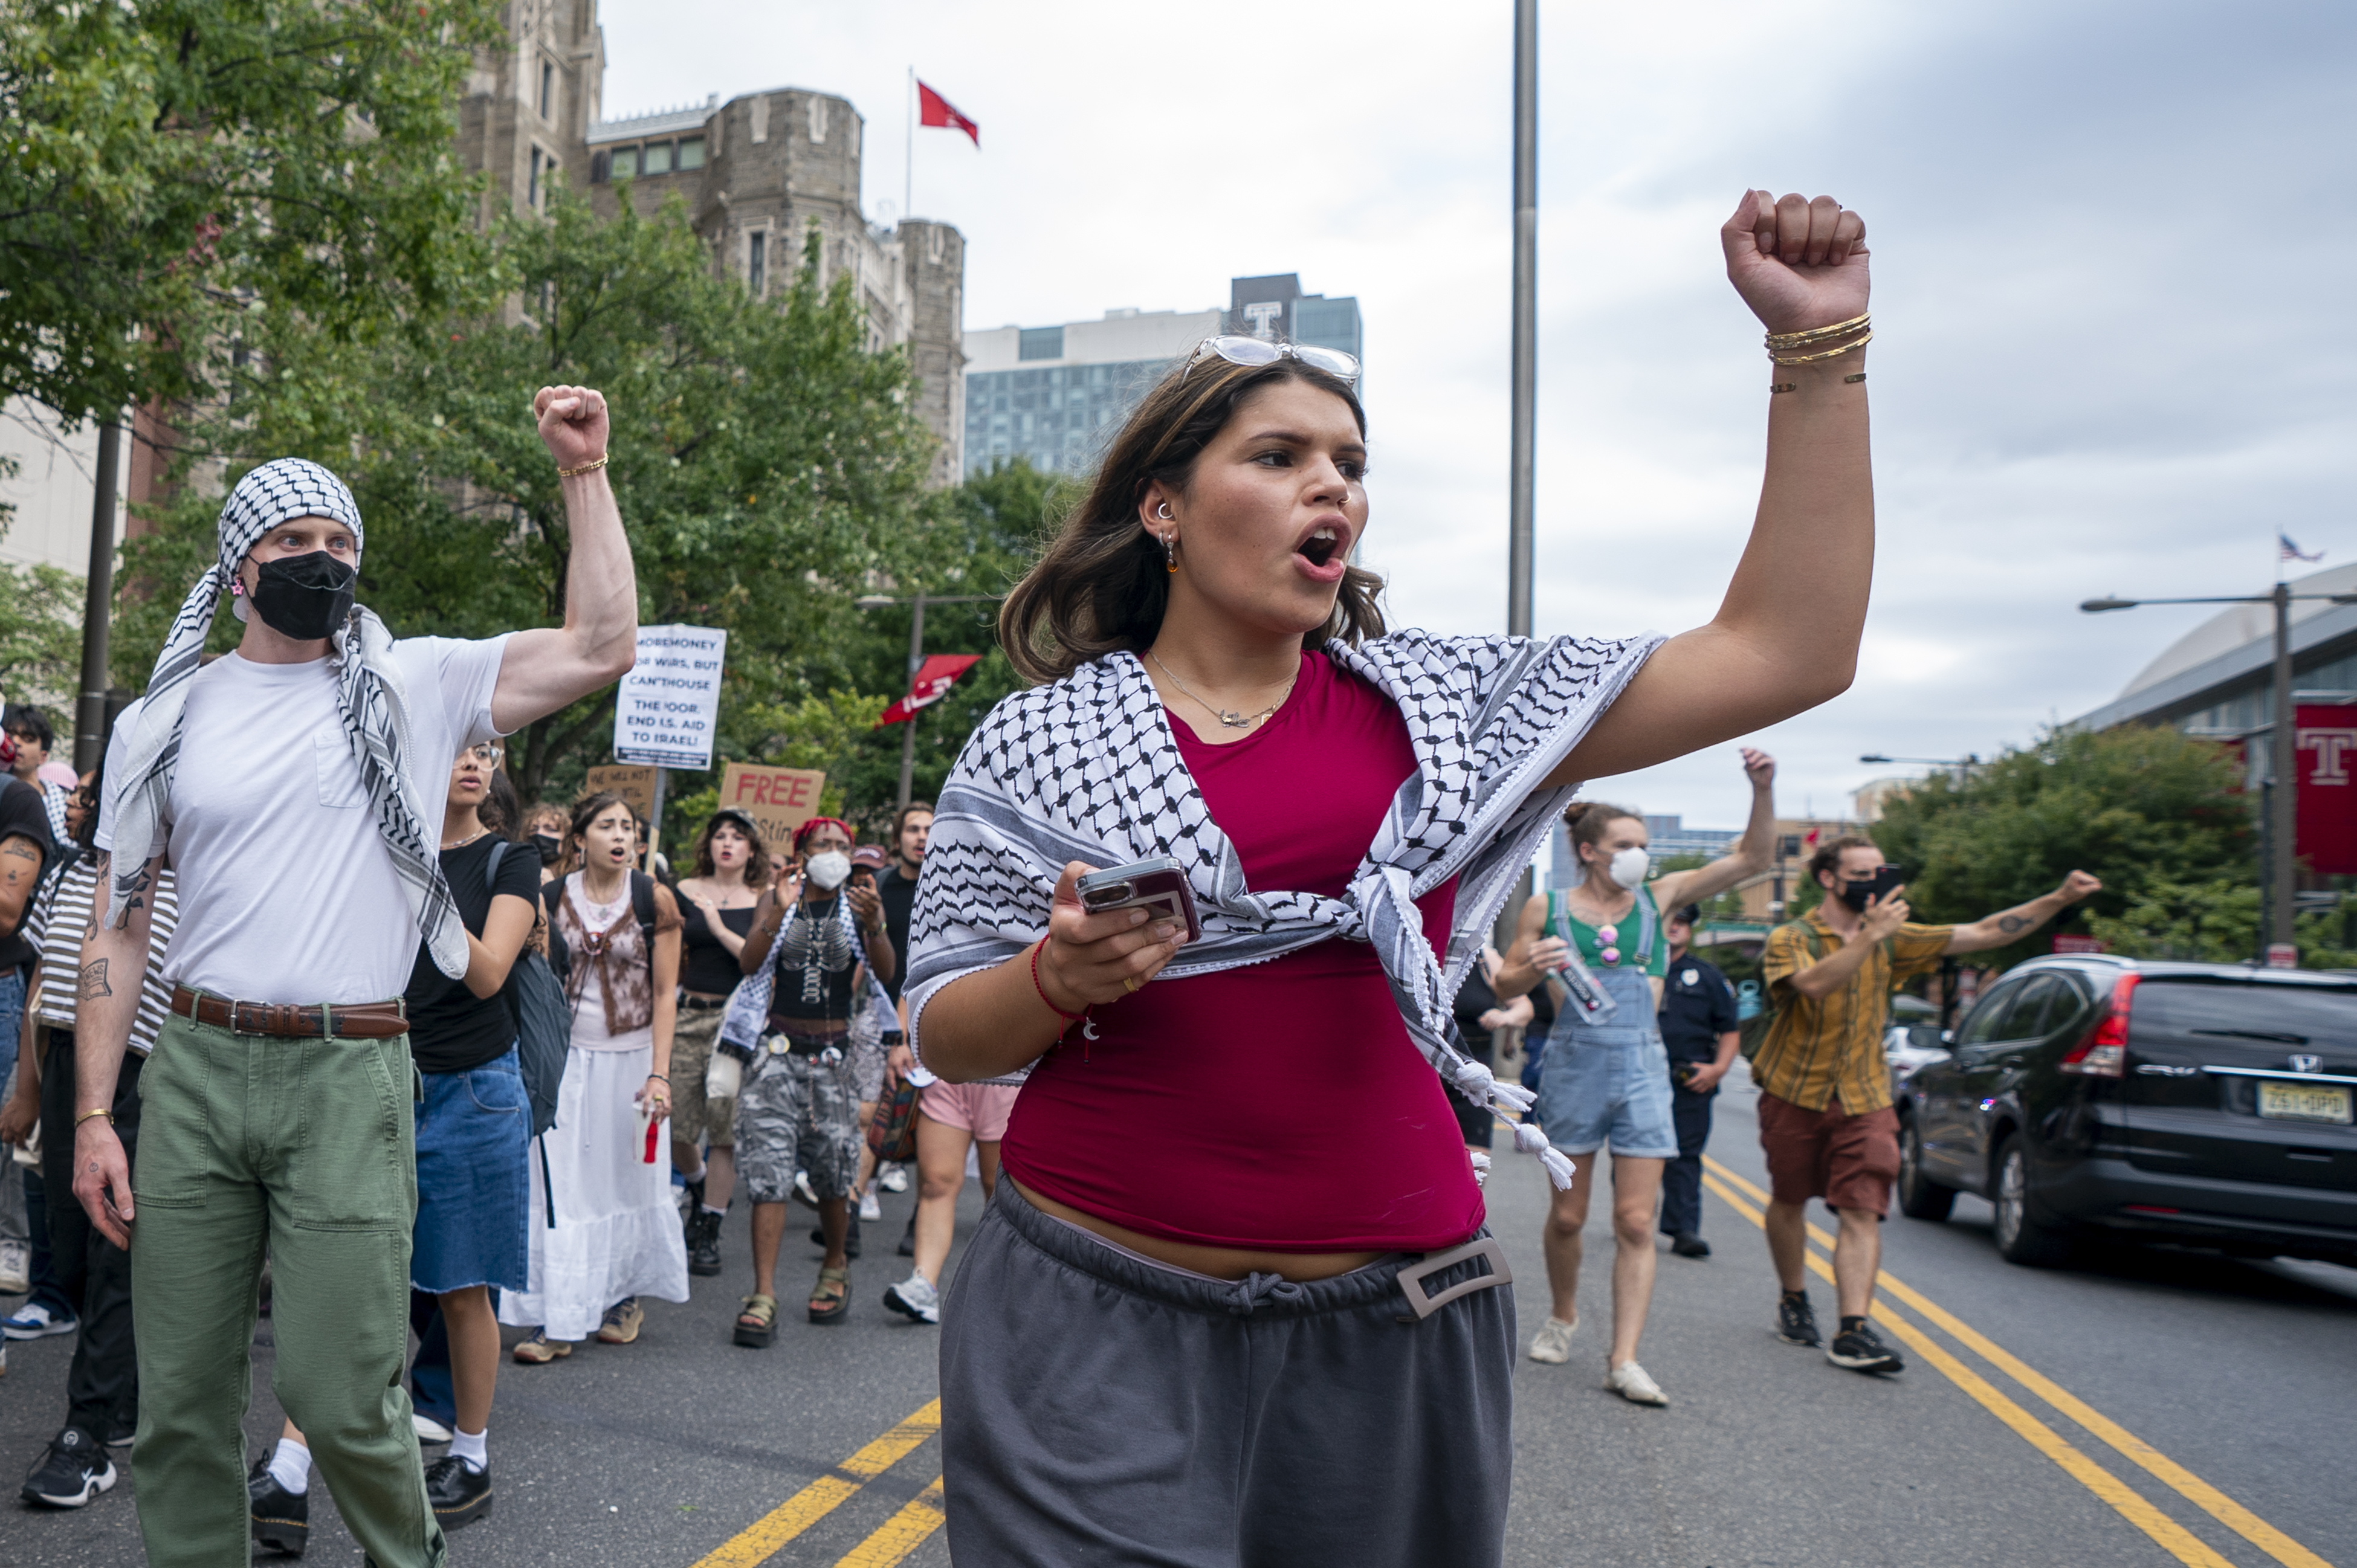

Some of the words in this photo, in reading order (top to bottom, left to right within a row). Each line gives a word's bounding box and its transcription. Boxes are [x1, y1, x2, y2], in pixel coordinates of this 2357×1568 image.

[694, 660, 718, 670] BUT
[635, 700, 660, 711] THE
[627, 715, 655, 727] END
[681, 720, 705, 731] AID
[633, 732, 650, 743] TO
[630, 768, 651, 782] NOT
[736, 772, 812, 808] FREE
